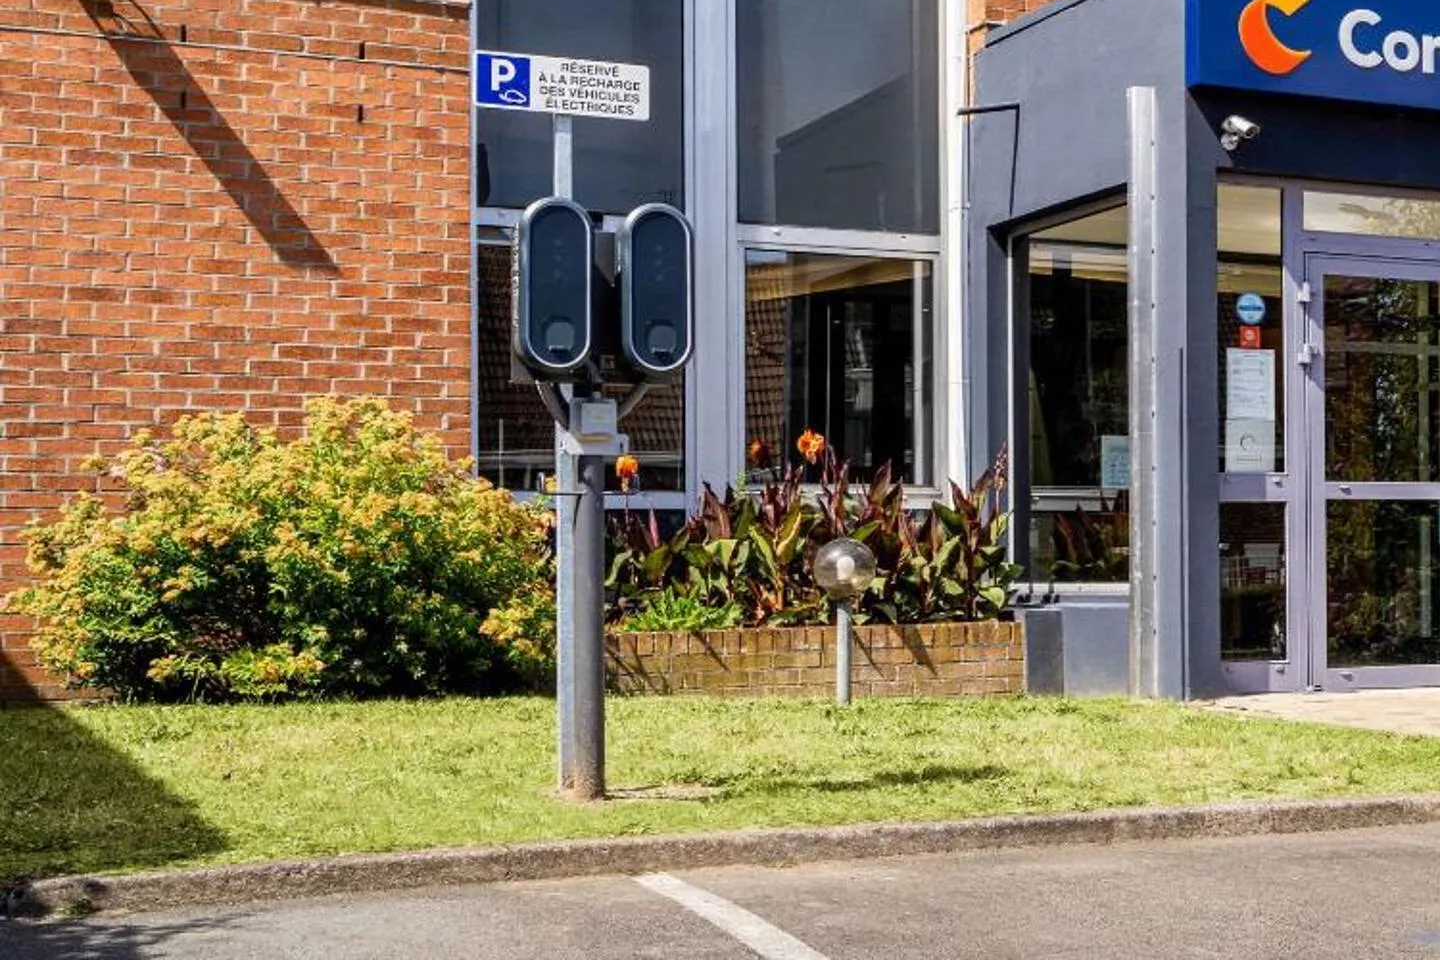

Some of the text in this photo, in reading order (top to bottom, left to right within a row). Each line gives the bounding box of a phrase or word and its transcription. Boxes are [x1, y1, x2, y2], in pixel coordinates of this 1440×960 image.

[491, 58, 517, 91] P
[560, 61, 620, 78] RÉSERVÉ
[550, 73, 567, 85] LA
[569, 75, 641, 91] RECHARGE
[539, 85, 566, 97] DES
